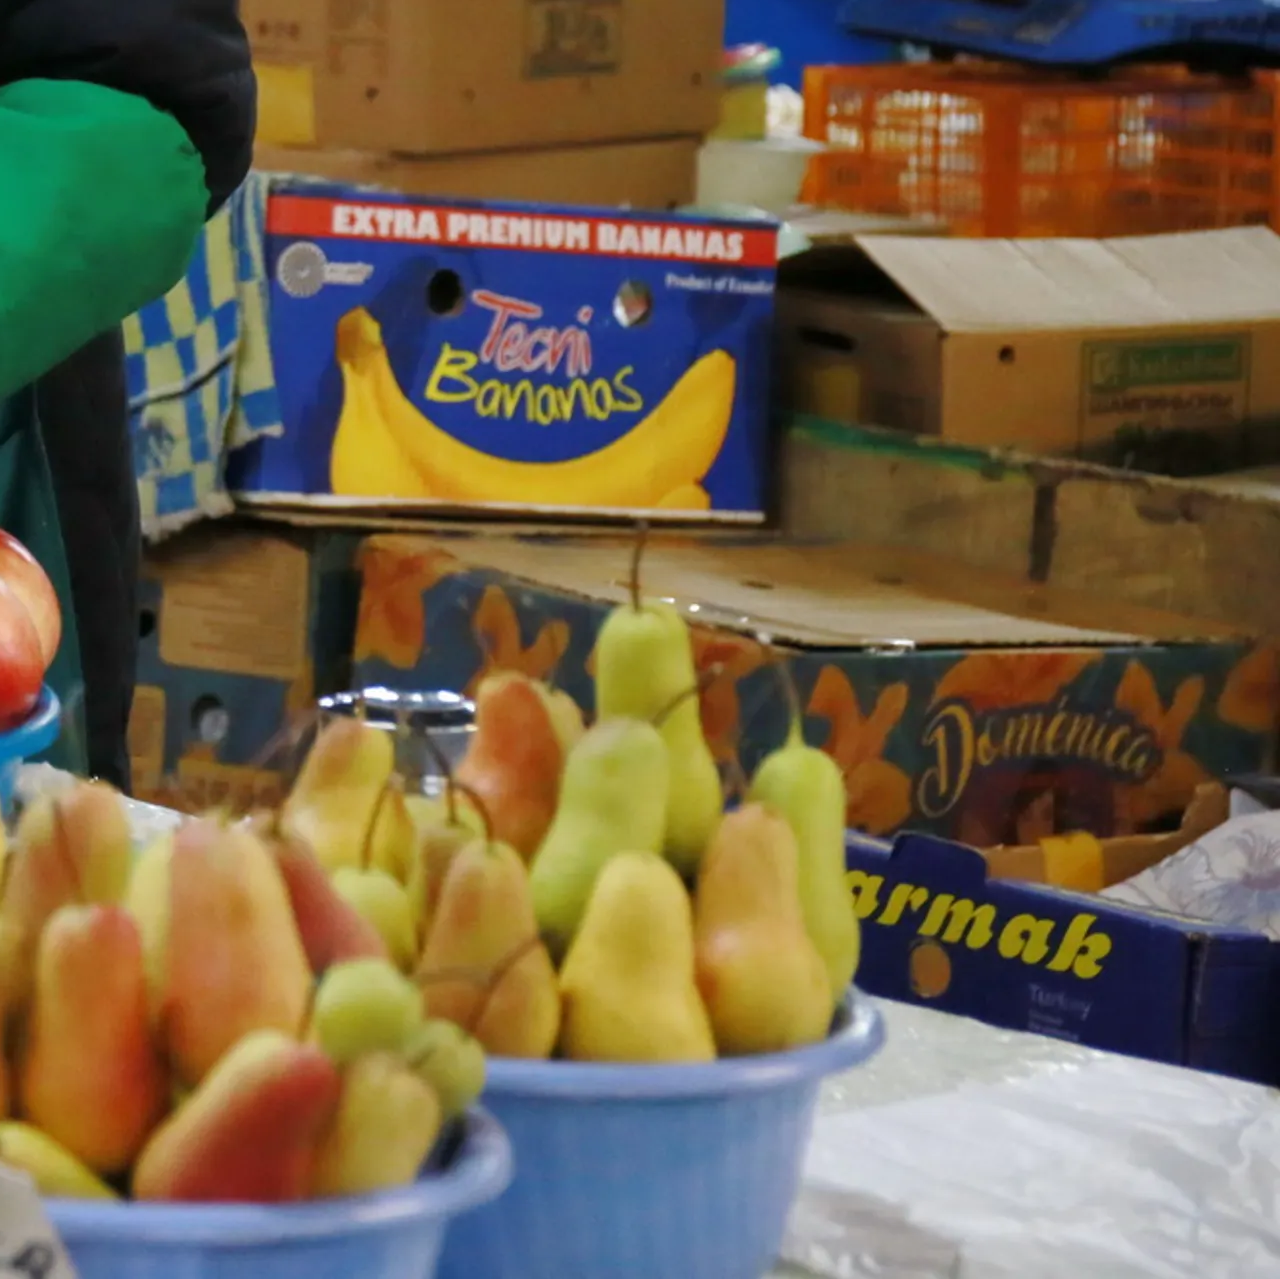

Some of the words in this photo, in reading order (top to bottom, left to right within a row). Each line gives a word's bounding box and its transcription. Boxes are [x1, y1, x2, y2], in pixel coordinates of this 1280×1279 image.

[331, 204, 441, 241] EXTRA
[447, 212, 590, 250] PREMIUM
[596, 222, 744, 261] BANANAS
[472, 289, 593, 378] Tecni
[424, 343, 644, 426] Bananas
[845, 867, 1112, 980] armak
